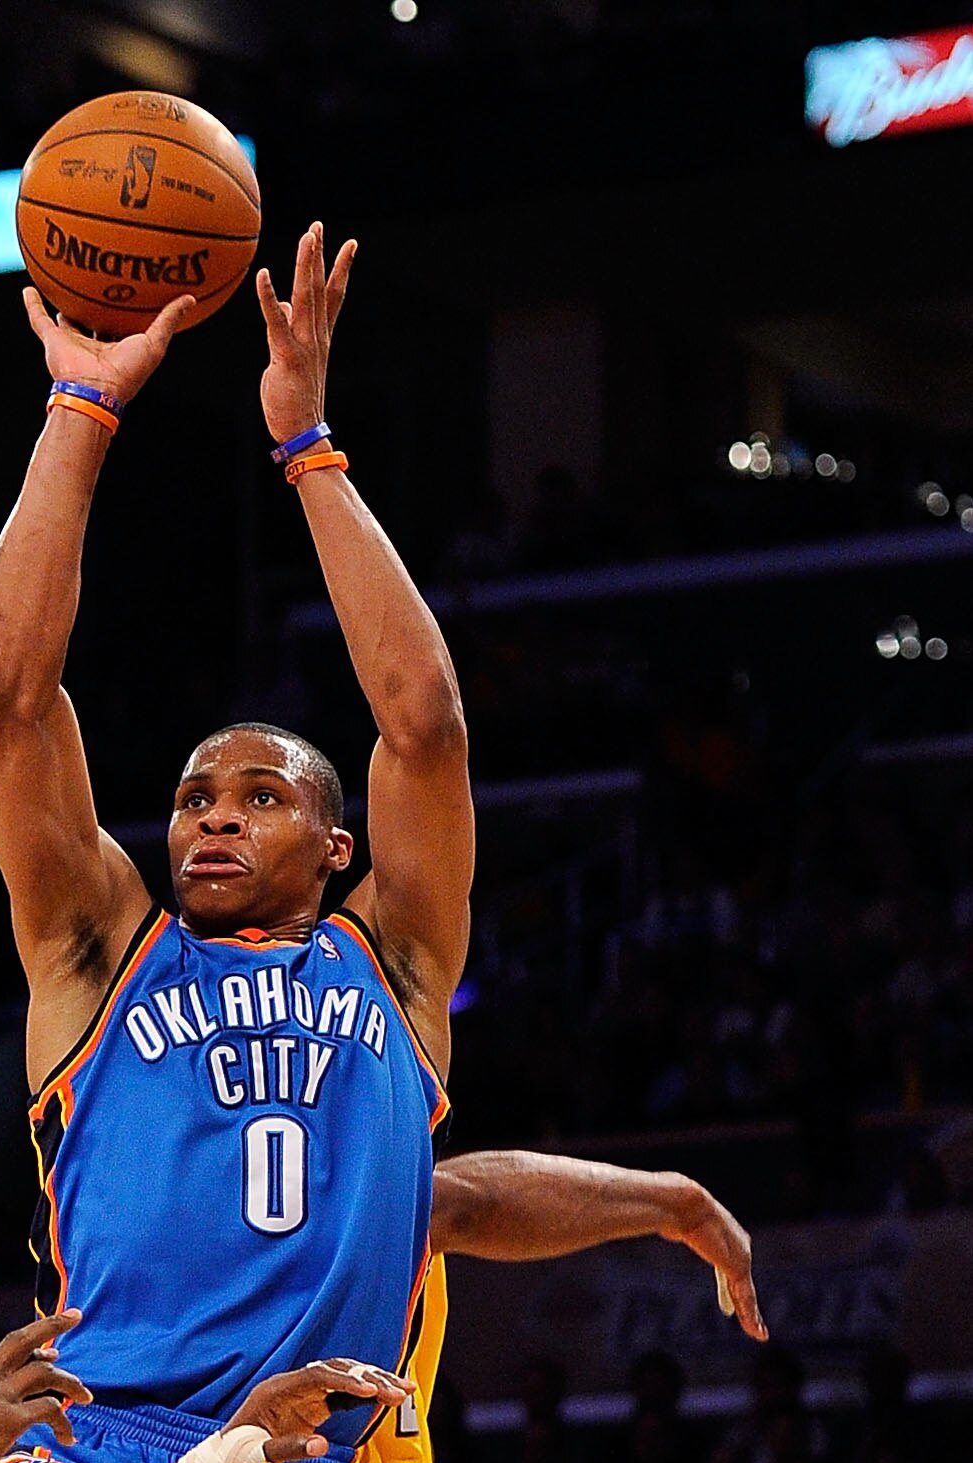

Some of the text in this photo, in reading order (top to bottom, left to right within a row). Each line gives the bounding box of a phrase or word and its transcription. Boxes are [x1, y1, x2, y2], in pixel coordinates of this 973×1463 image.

[44, 216, 210, 286] SPALDING
[125, 964, 387, 1064] OKLAHOMA
[207, 1034, 337, 1110] CITY
[241, 1113, 309, 1236] 0
